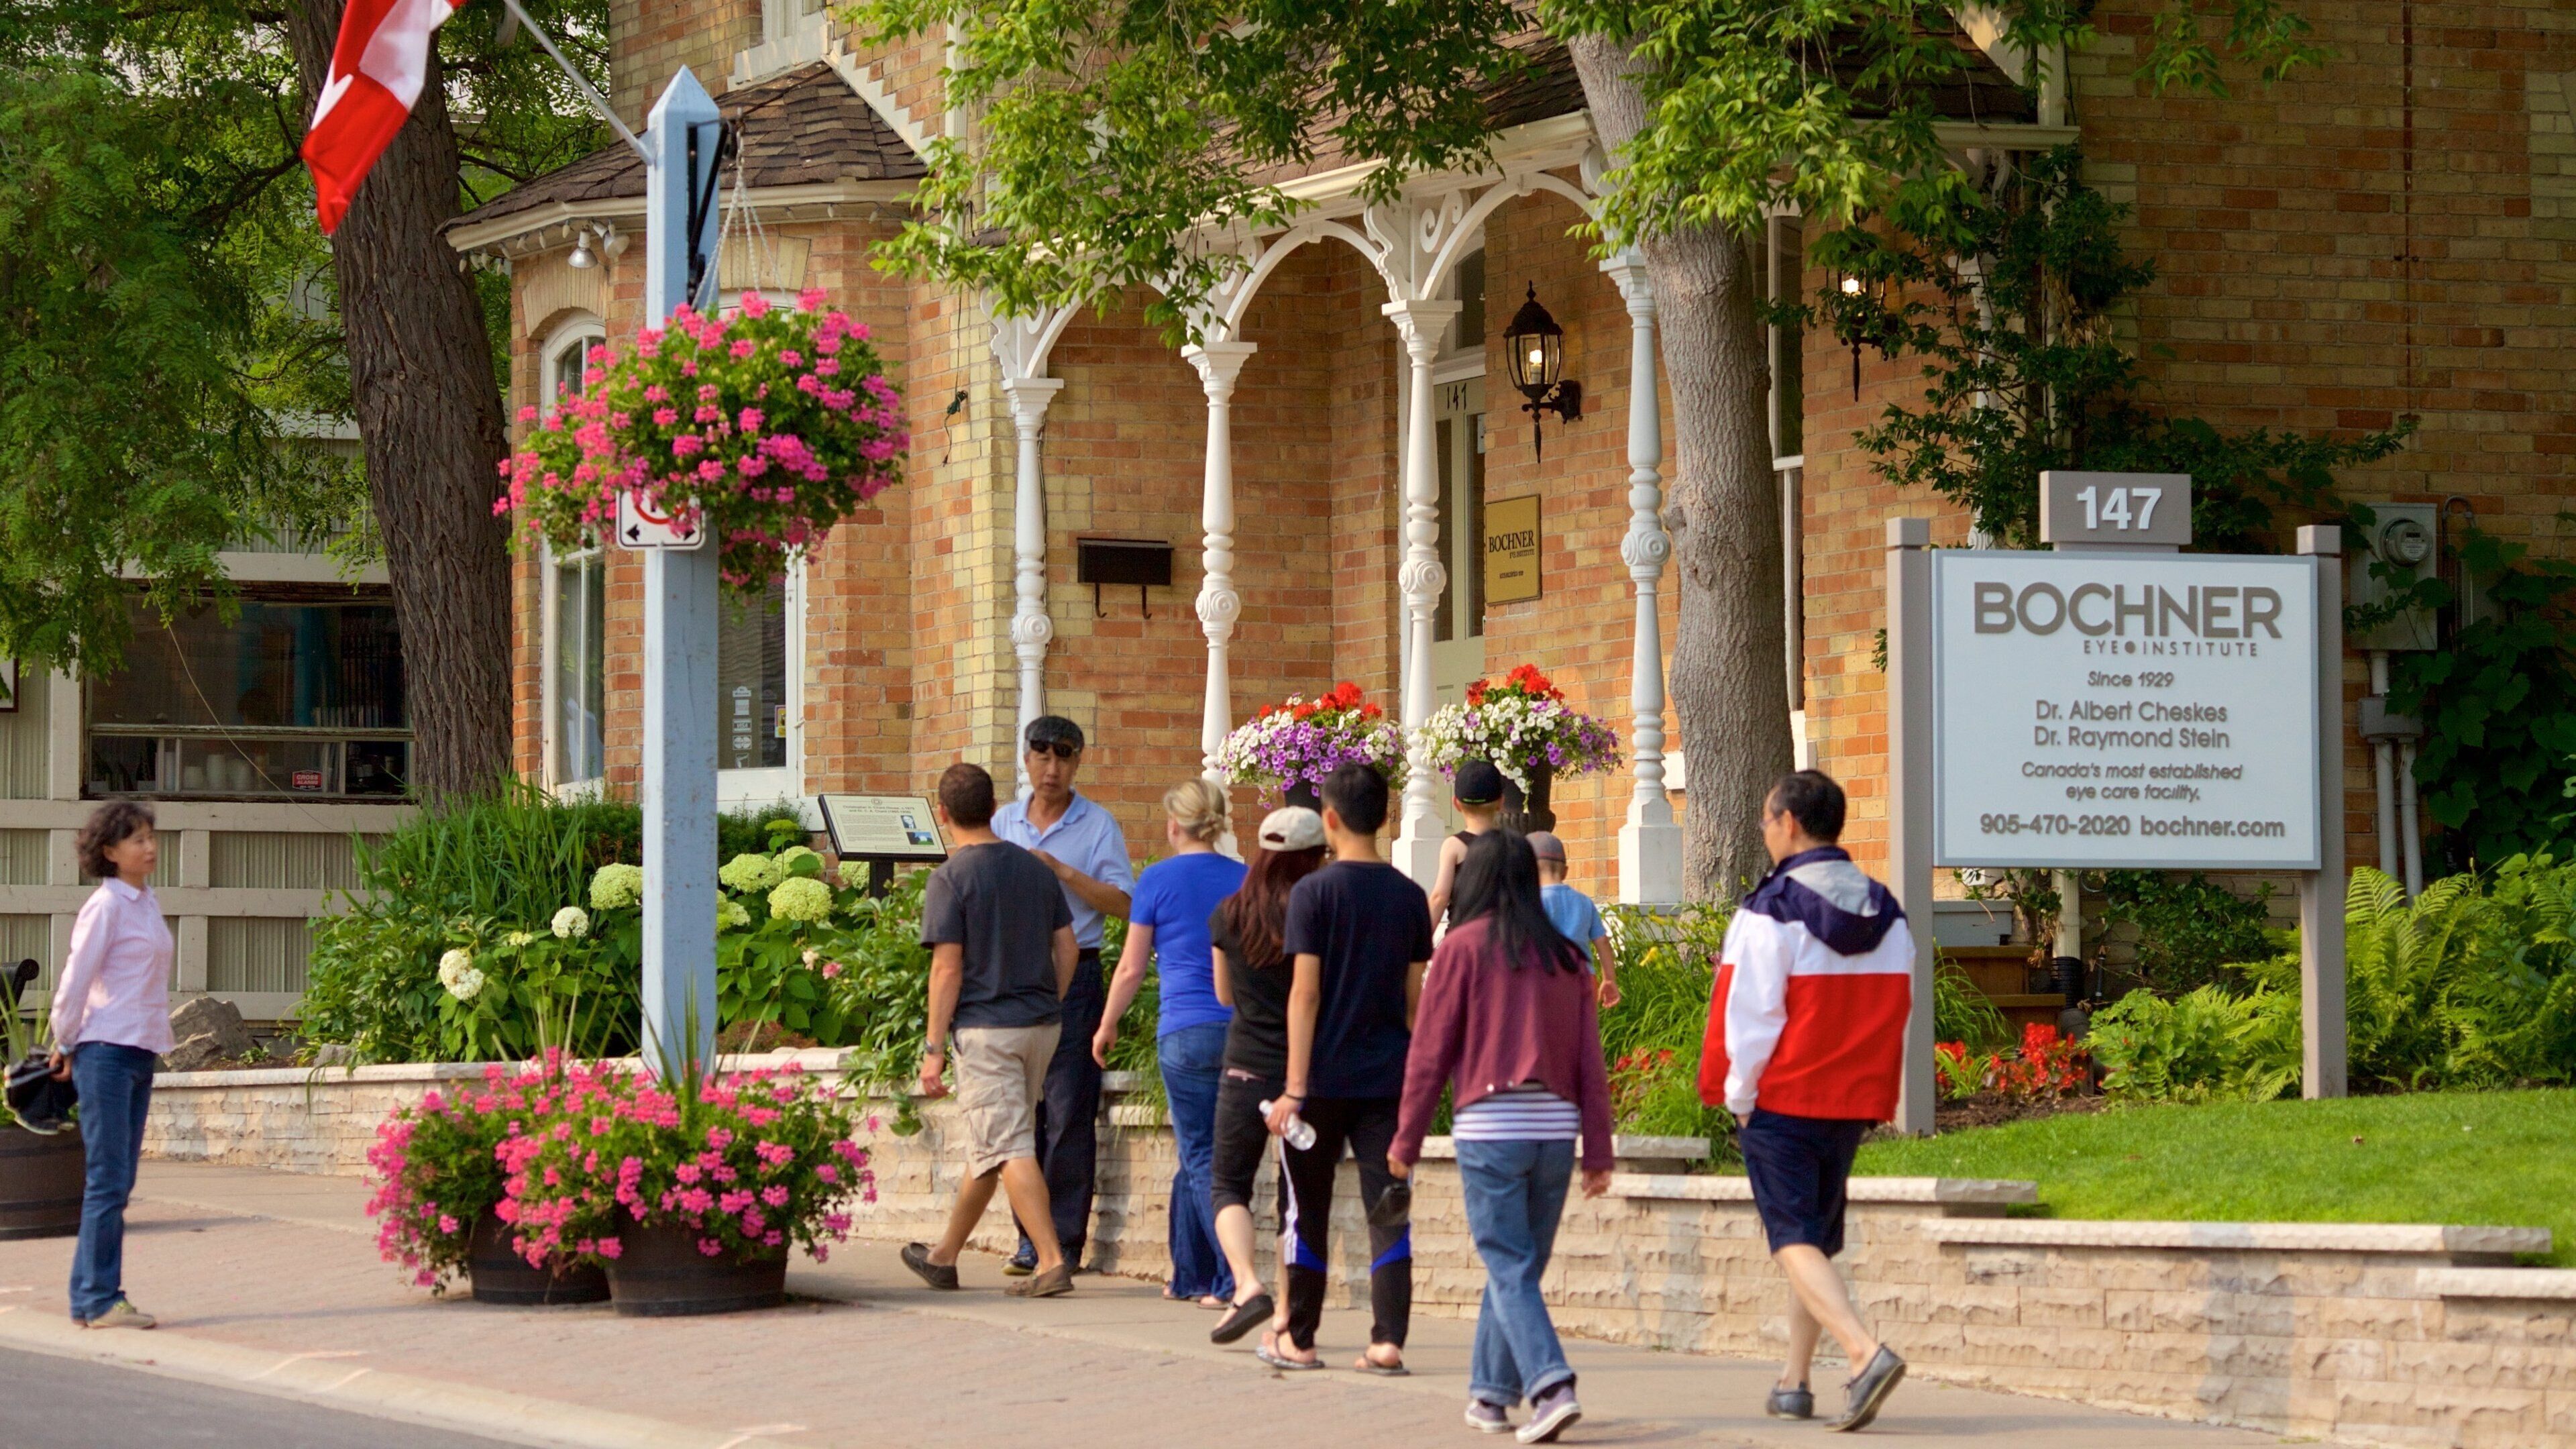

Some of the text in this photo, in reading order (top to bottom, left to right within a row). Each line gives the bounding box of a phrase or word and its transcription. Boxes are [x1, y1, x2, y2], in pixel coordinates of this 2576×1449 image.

[2076, 486, 2162, 529] 147
[1488, 529, 1535, 553] BOCHNER
[1974, 581, 2283, 639] BOCHNER
[2083, 639, 2258, 657] EYE INSTITUTE
[2087, 670, 2175, 688] Since 1929
[2035, 699, 2229, 723] Dr. Albert Cheskes
[2034, 725, 2231, 751] Dr. Raymond Stein
[2021, 761, 2243, 780] Canada's most established
[2065, 784, 2201, 804] eye care facility.
[1979, 812, 2286, 839] 905-470-2020 bochner.com
